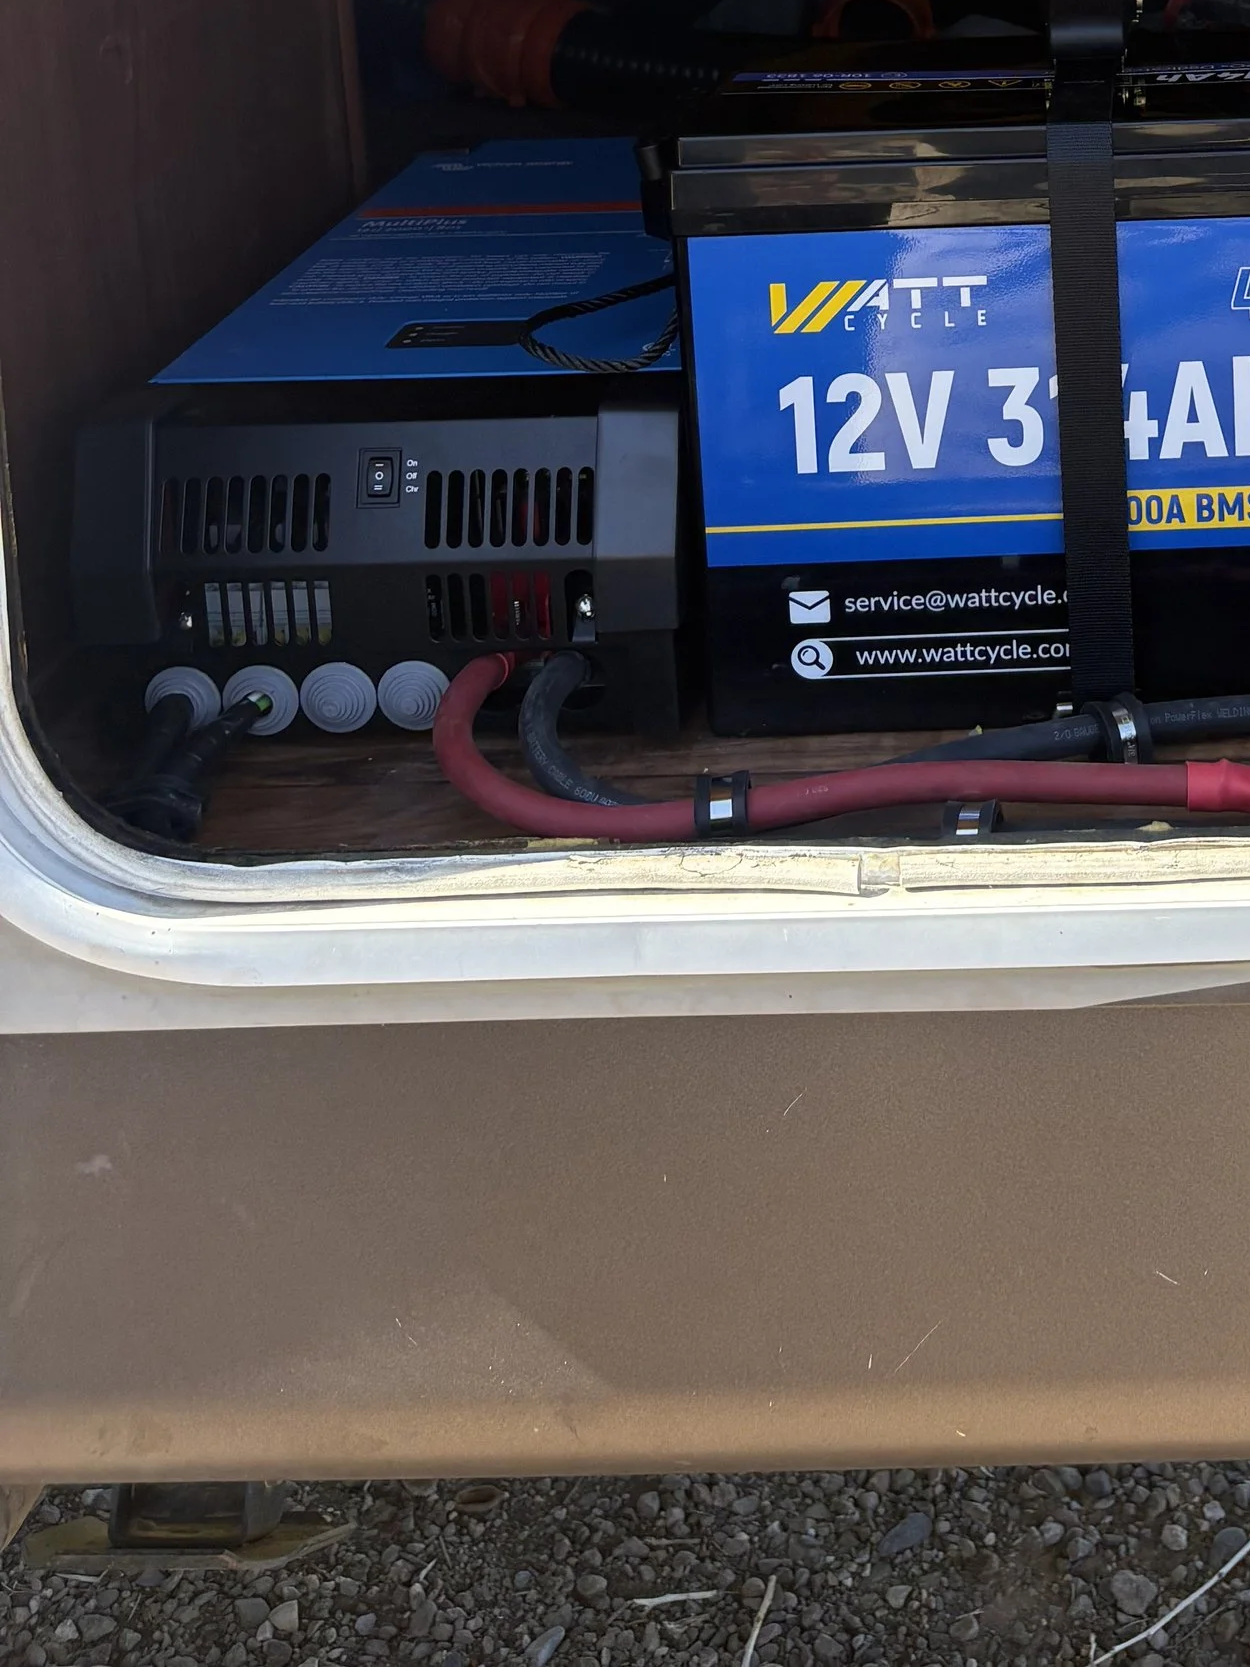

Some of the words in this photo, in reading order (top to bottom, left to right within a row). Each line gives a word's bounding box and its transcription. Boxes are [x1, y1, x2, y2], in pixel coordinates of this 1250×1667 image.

[769, 275, 988, 334] WATT
[844, 309, 987, 331] CYCLE
[779, 370, 955, 475] 12V
[406, 459, 418, 467] On
[1127, 493, 1186, 527] 00A
